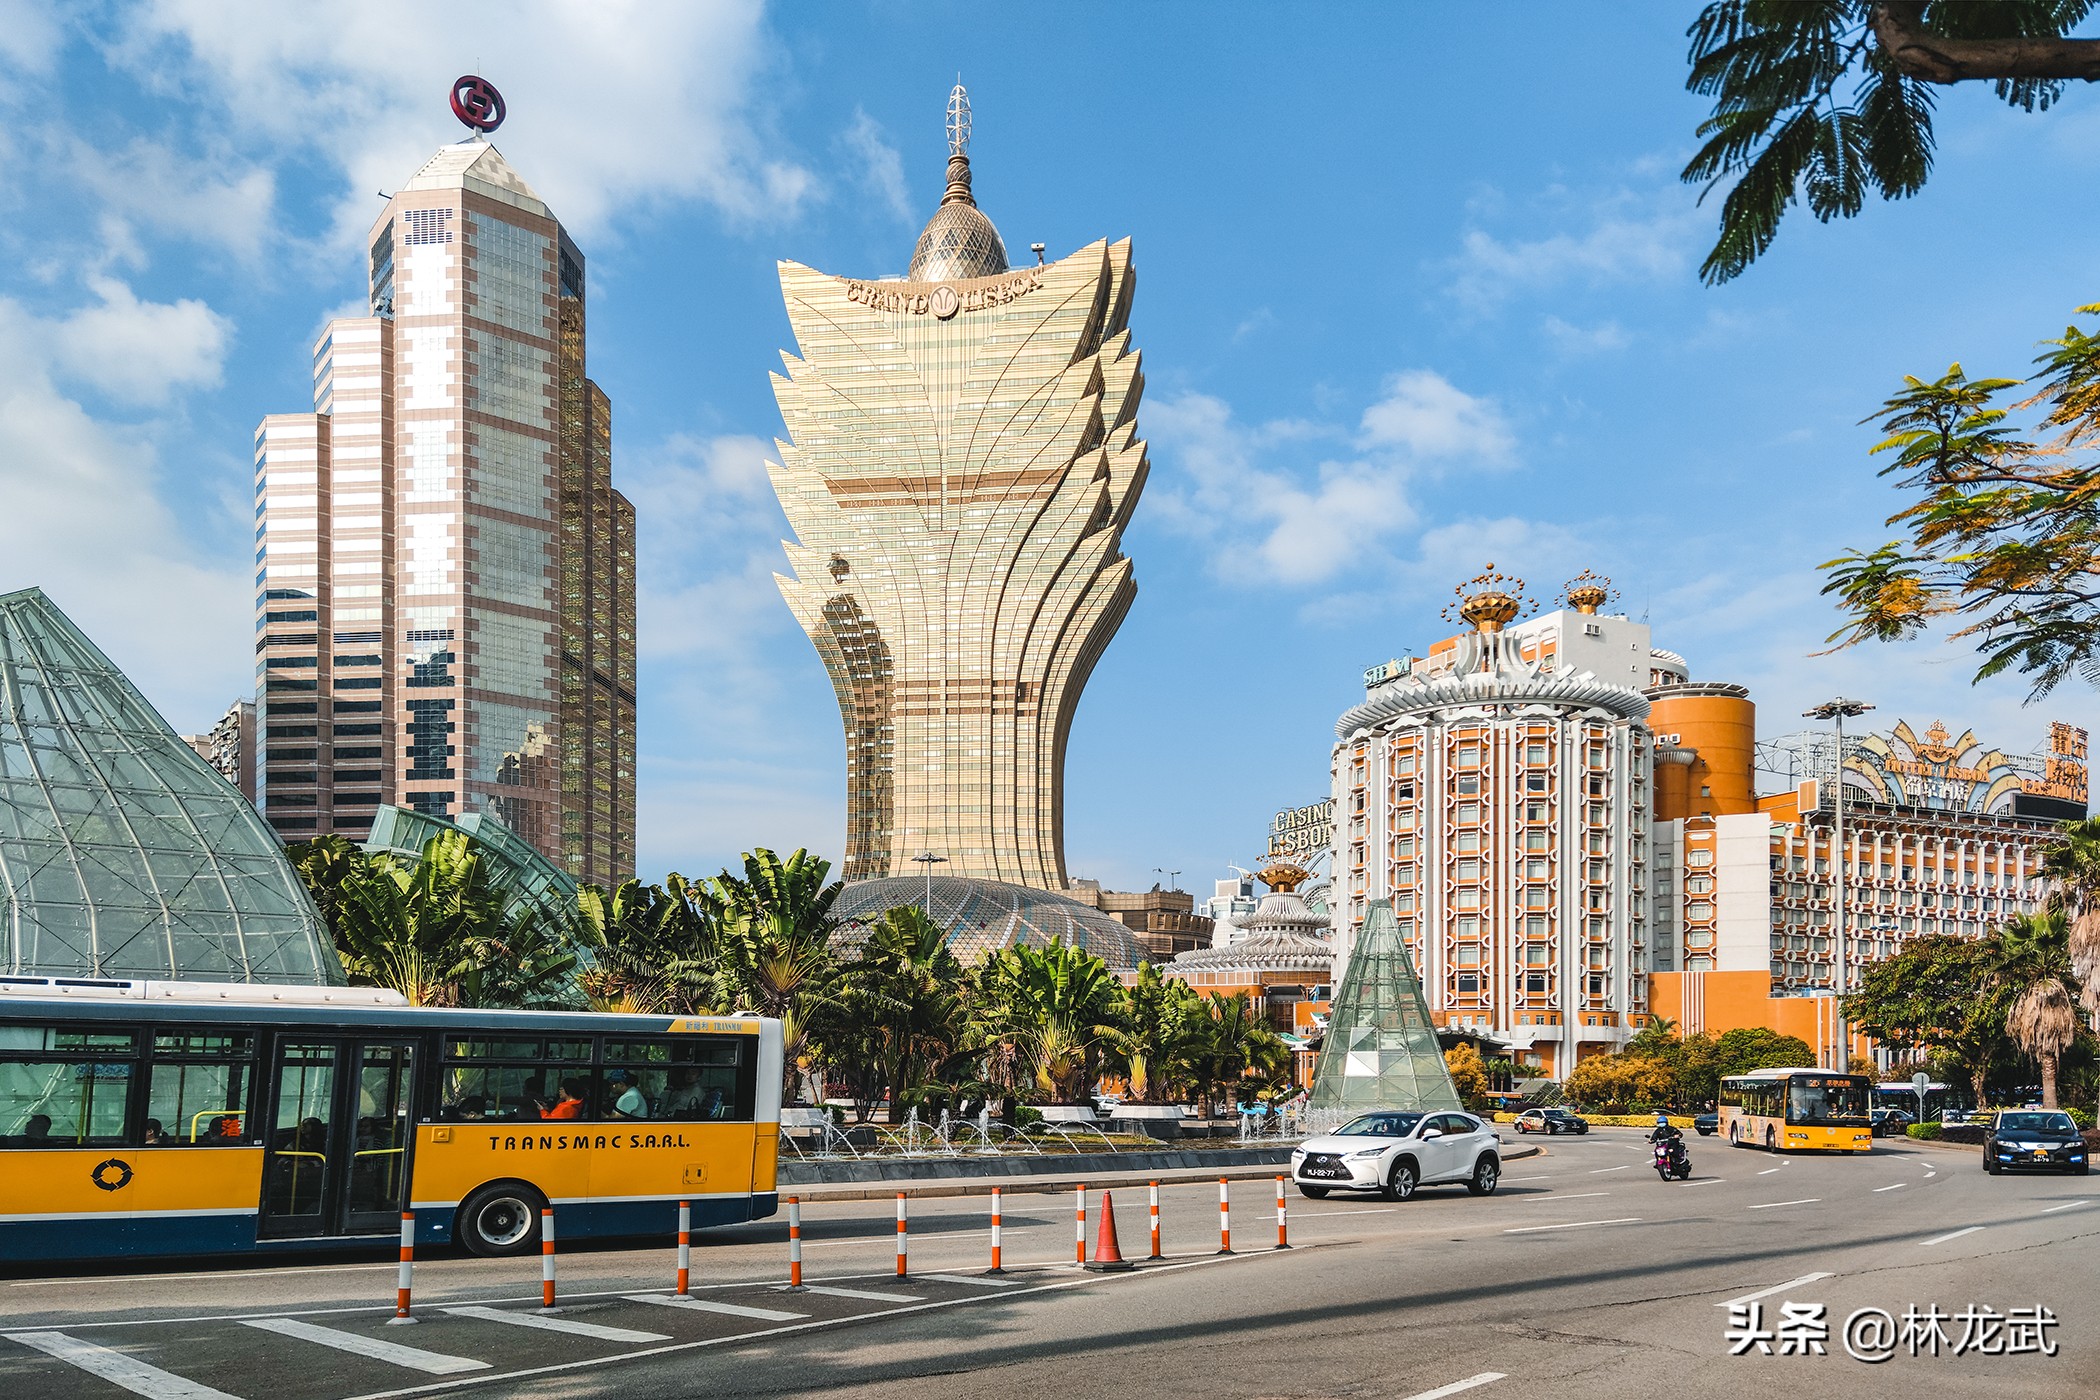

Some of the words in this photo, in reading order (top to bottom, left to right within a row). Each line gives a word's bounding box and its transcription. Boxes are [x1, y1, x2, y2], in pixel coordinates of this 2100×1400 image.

[847, 281, 931, 316] GRAND
[959, 274, 1044, 312] LISBOA
[1884, 759, 1933, 777] HOTEL
[1939, 765, 1990, 783] LISBOA
[1275, 801, 1332, 832] CASINO
[1267, 823, 1332, 857] LISBOA
[714, 1022, 742, 1031] TRANSMAC
[489, 1135, 622, 1150] TRANSMAC
[629, 1134, 691, 1149] S.A.R.L.
